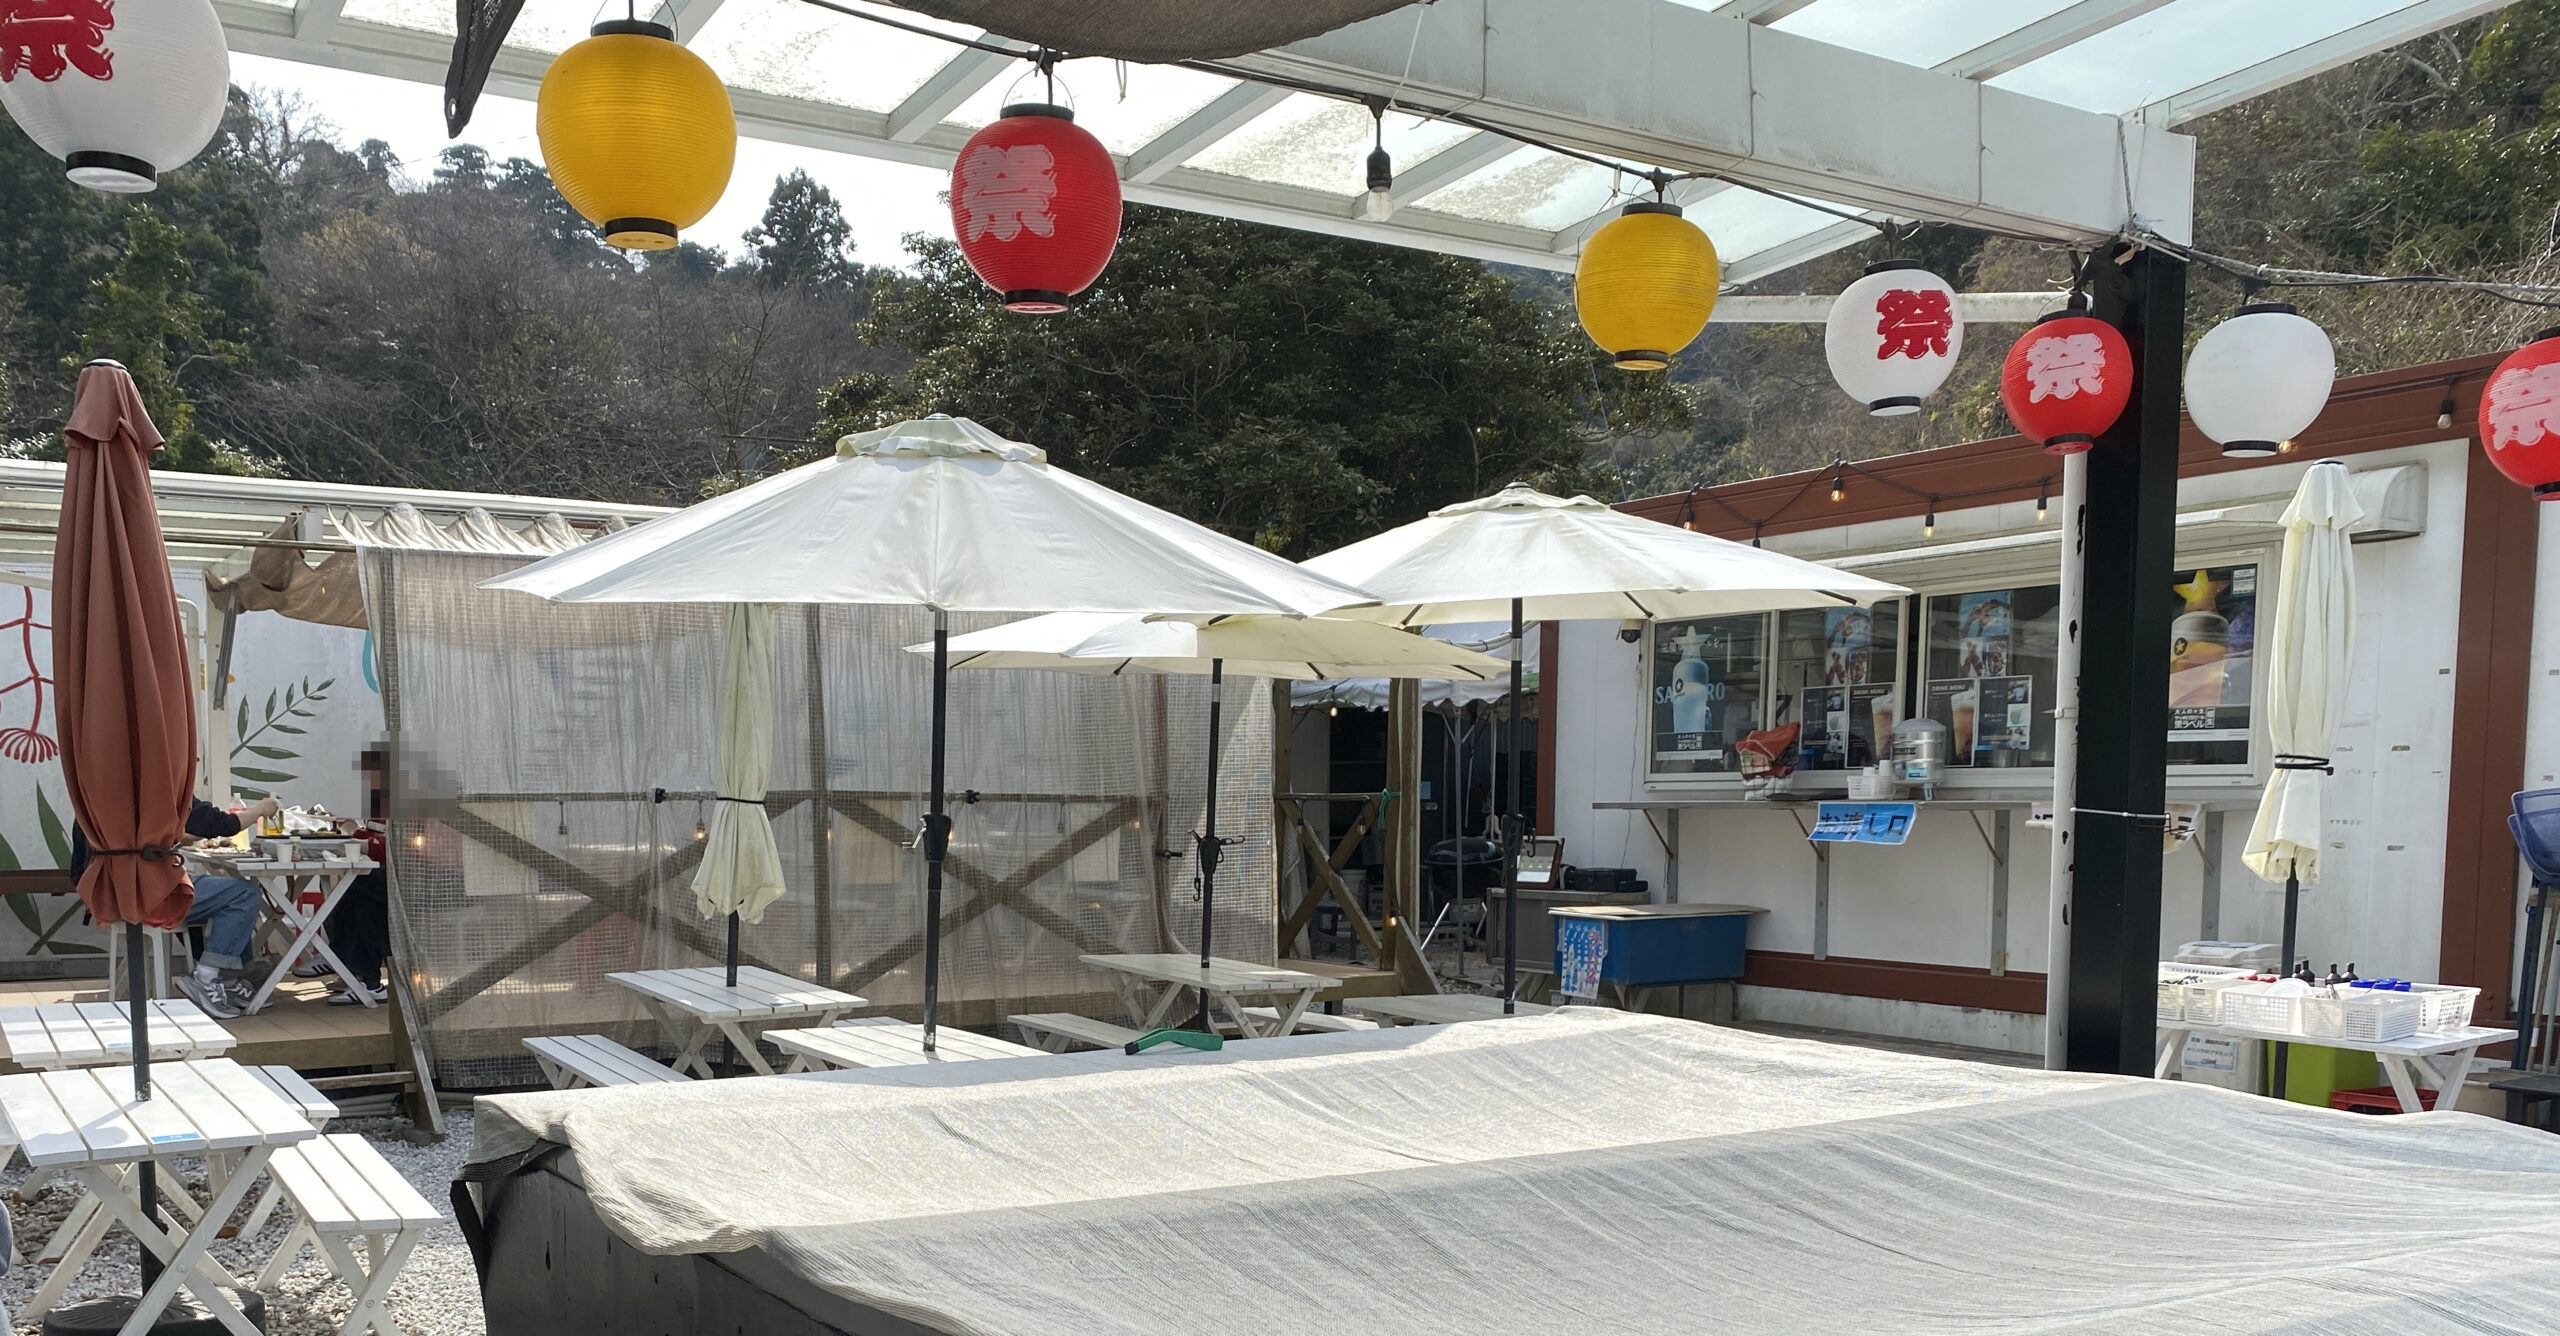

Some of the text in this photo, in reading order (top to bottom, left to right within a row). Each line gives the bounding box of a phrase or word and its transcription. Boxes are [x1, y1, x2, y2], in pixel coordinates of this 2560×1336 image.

[962, 144, 1057, 242] 祭
[1876, 289, 1953, 360] 祭
[2027, 332, 2106, 404] 祭
[2488, 361, 2560, 451] 祭
[1586, 930, 1601, 983] ラムネ
